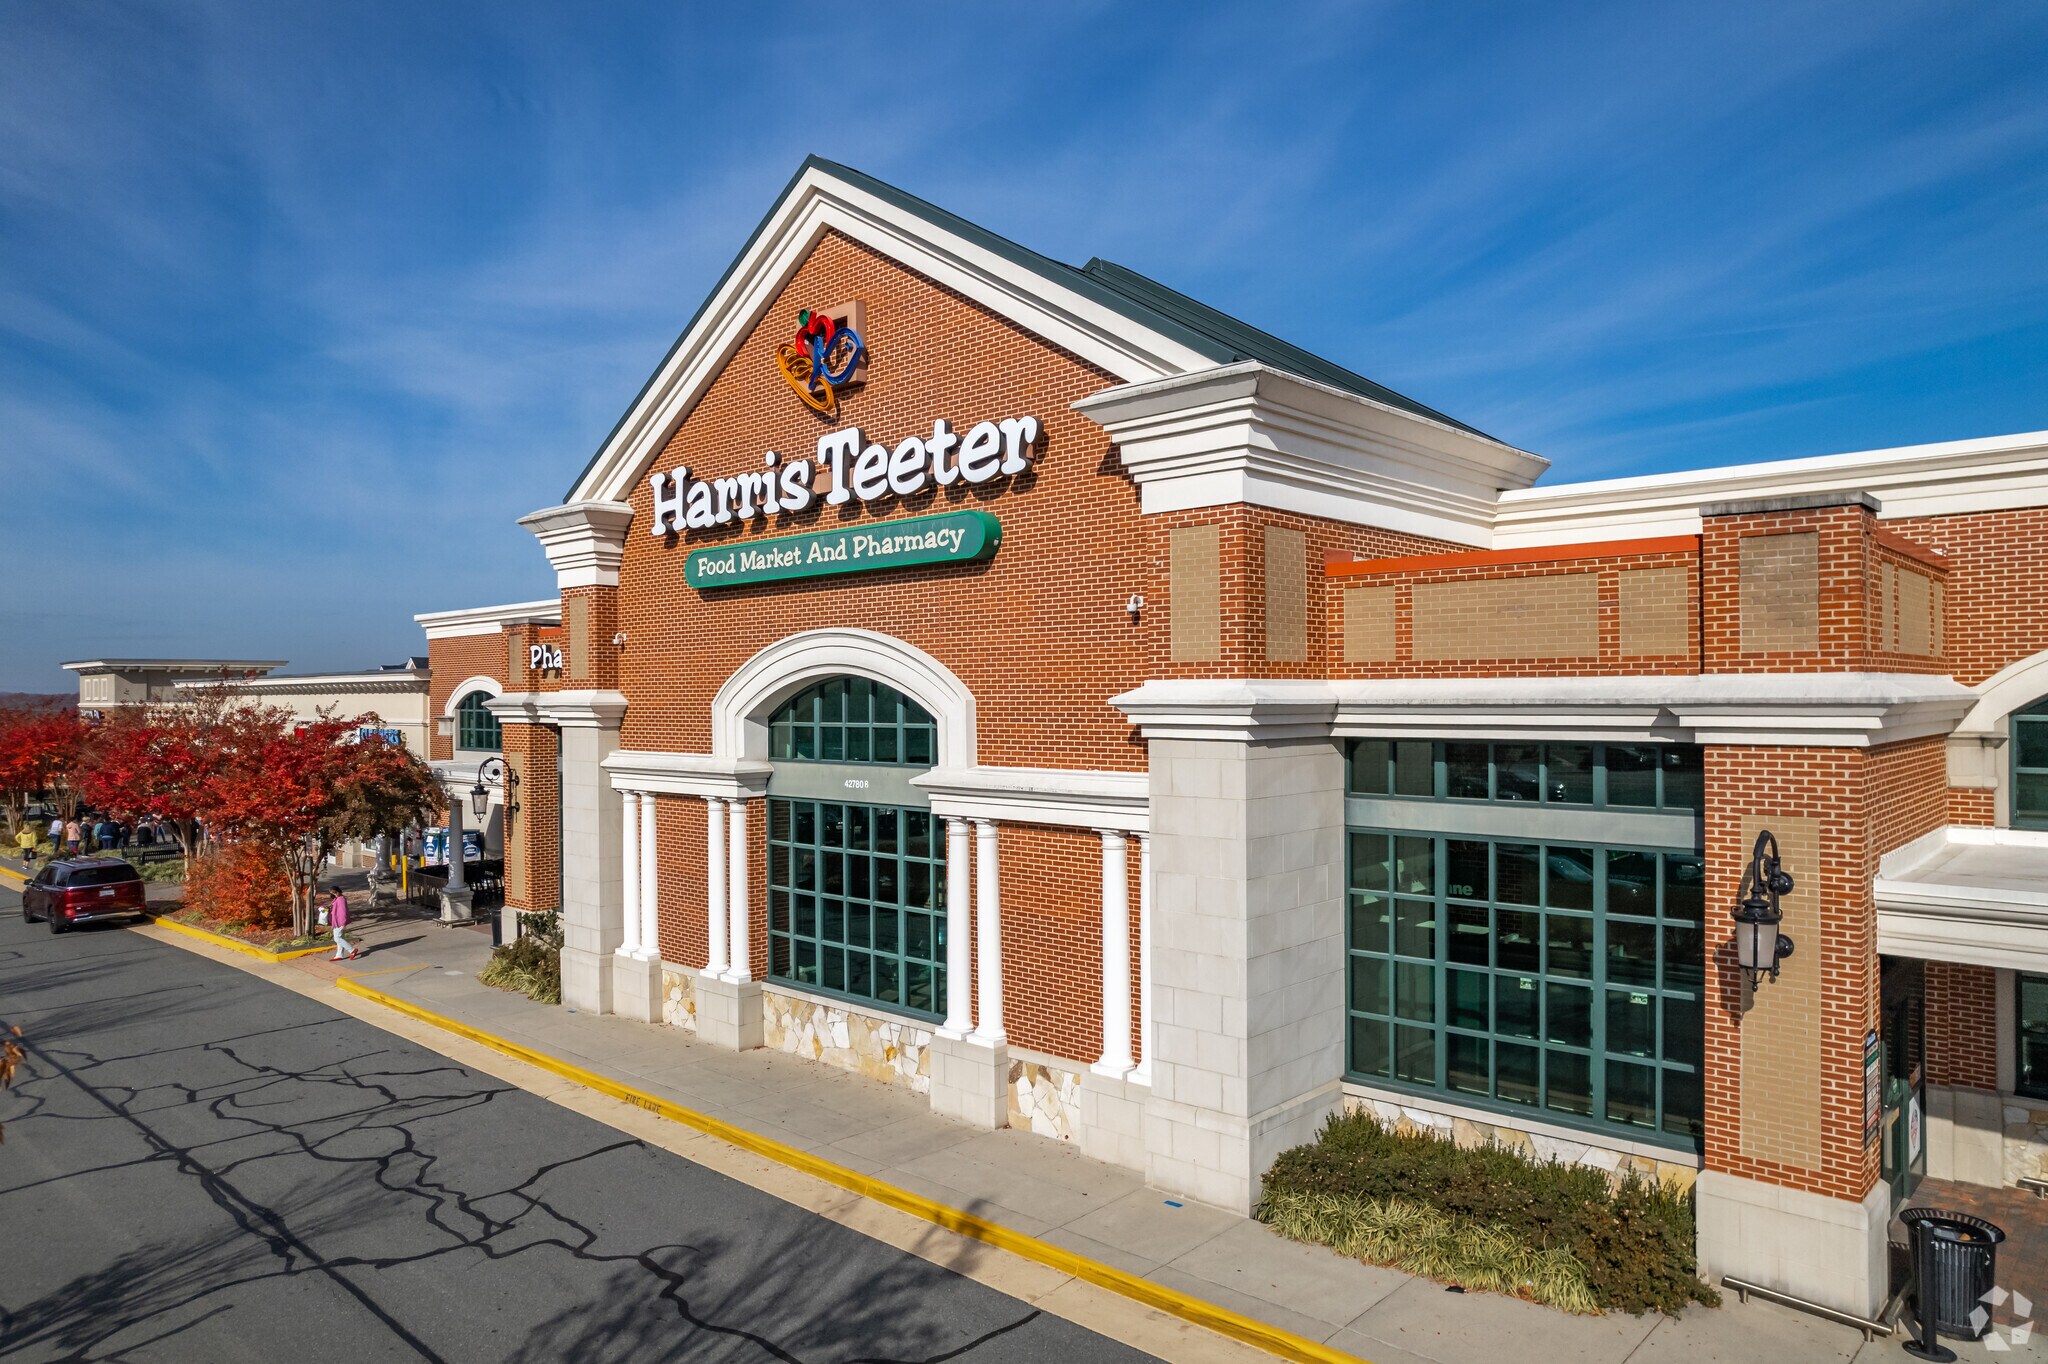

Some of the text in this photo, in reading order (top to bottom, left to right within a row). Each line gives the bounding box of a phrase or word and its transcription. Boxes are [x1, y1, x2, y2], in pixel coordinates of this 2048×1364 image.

[650, 415, 1038, 536] Harris Teeter
[698, 528, 966, 578] Food Market And Pharmacy
[530, 644, 562, 669] Pha
[844, 780, 864, 788] 42780
[625, 1094, 661, 1114] FIRE LANE
